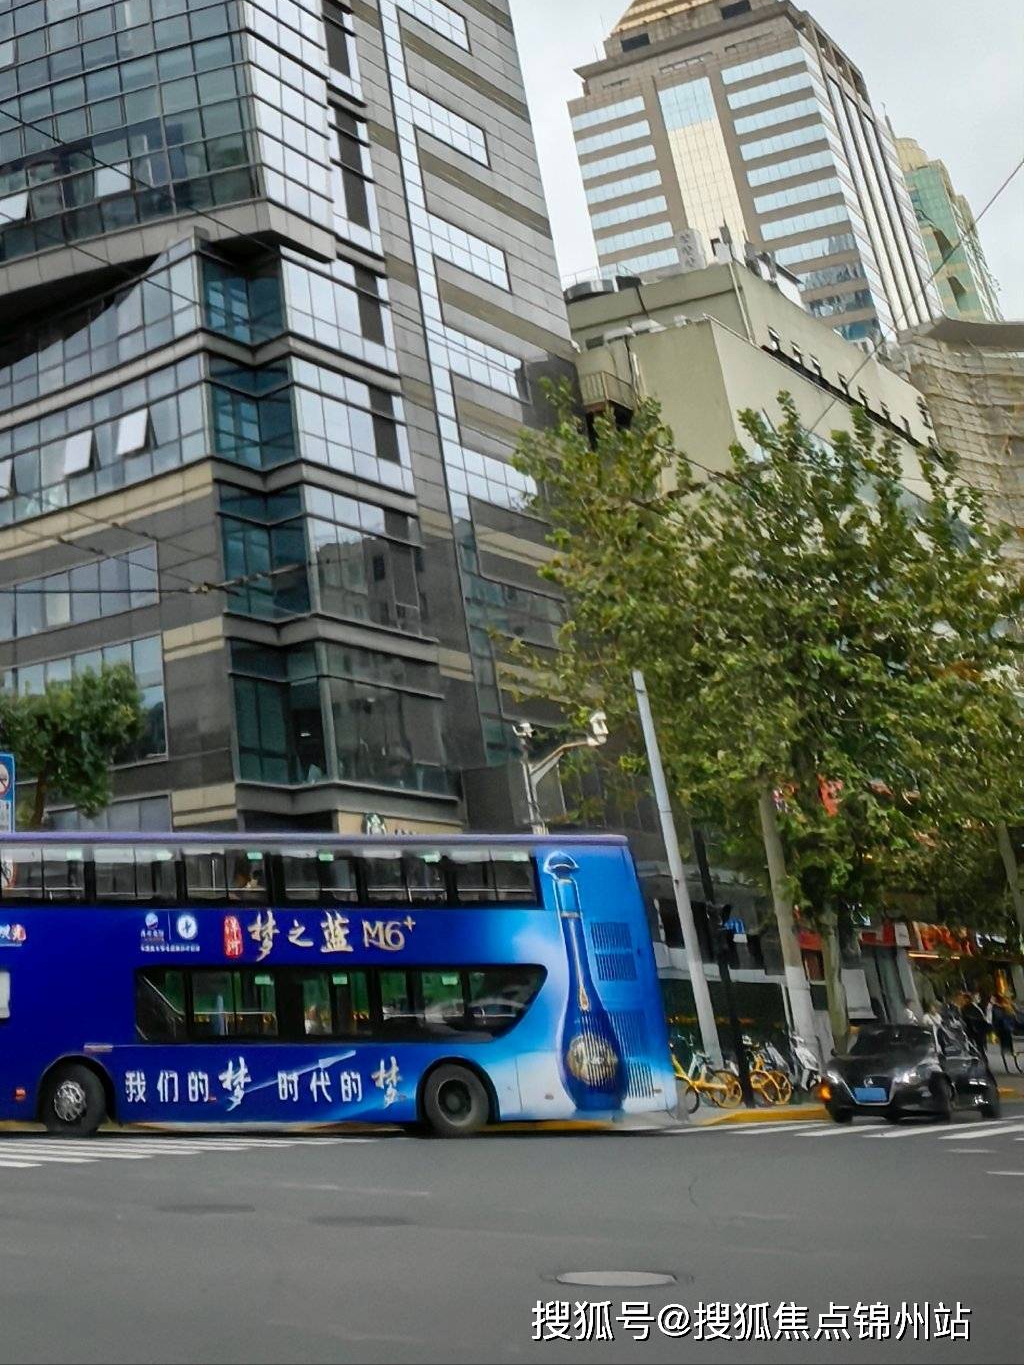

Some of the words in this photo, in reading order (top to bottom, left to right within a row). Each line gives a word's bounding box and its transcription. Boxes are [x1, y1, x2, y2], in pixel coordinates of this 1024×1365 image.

[247, 910, 353, 962] 梦之蓝
[125, 1056, 252, 1112] 我们的梦
[277, 1056, 403, 1109] 时代的梦
